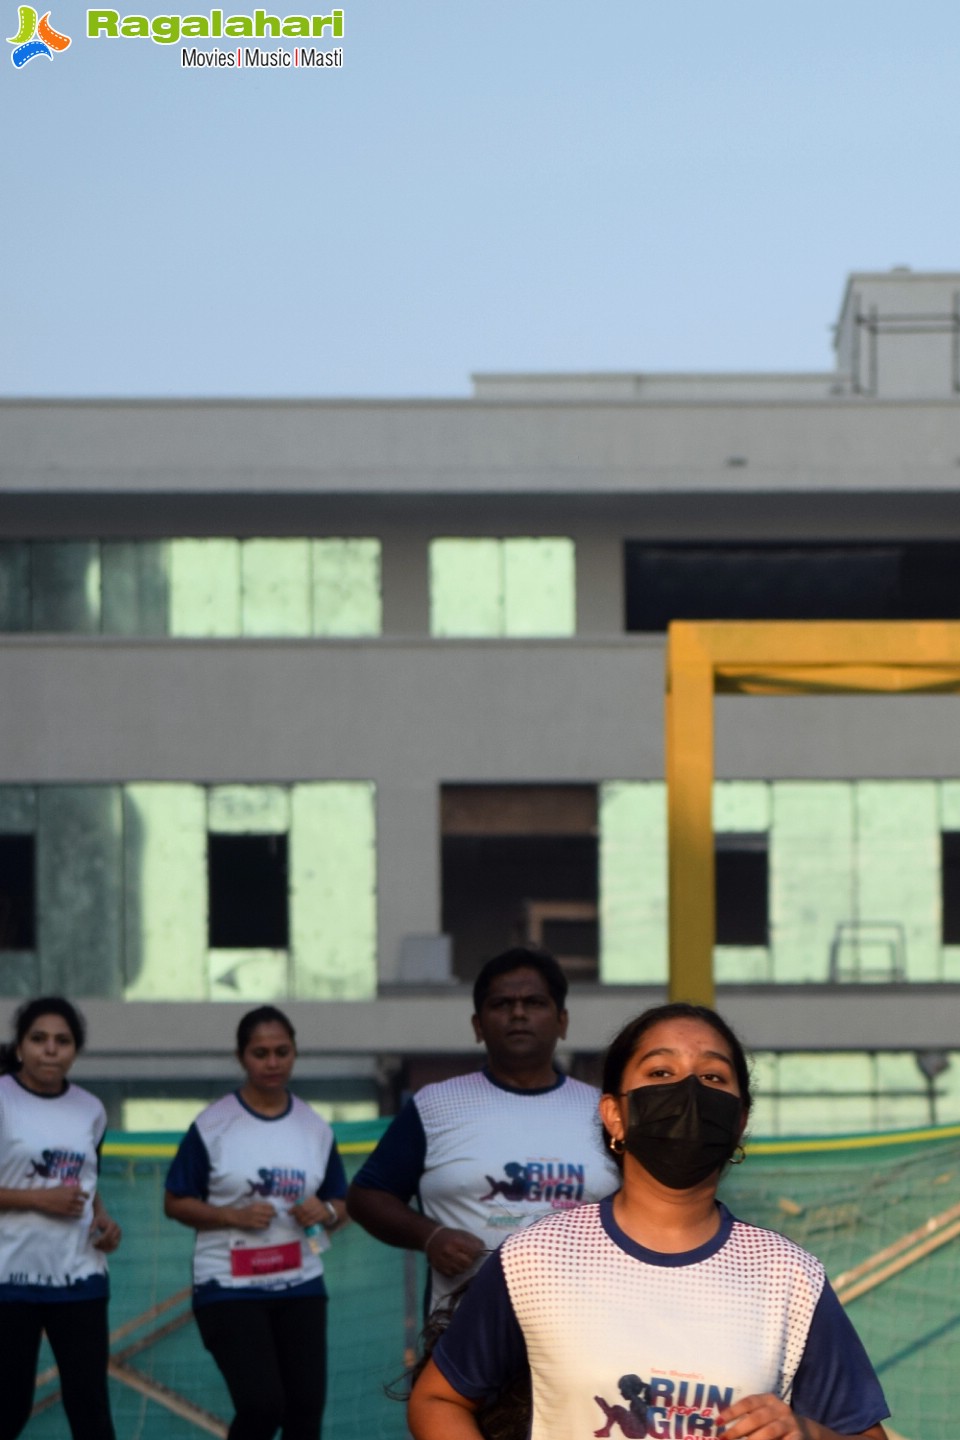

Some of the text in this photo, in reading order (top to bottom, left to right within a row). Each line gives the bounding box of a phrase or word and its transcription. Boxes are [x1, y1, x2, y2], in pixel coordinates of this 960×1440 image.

[527, 1162, 585, 1184] RUN
[650, 1377, 734, 1413] RUN
[666, 1406, 714, 1420] for a
